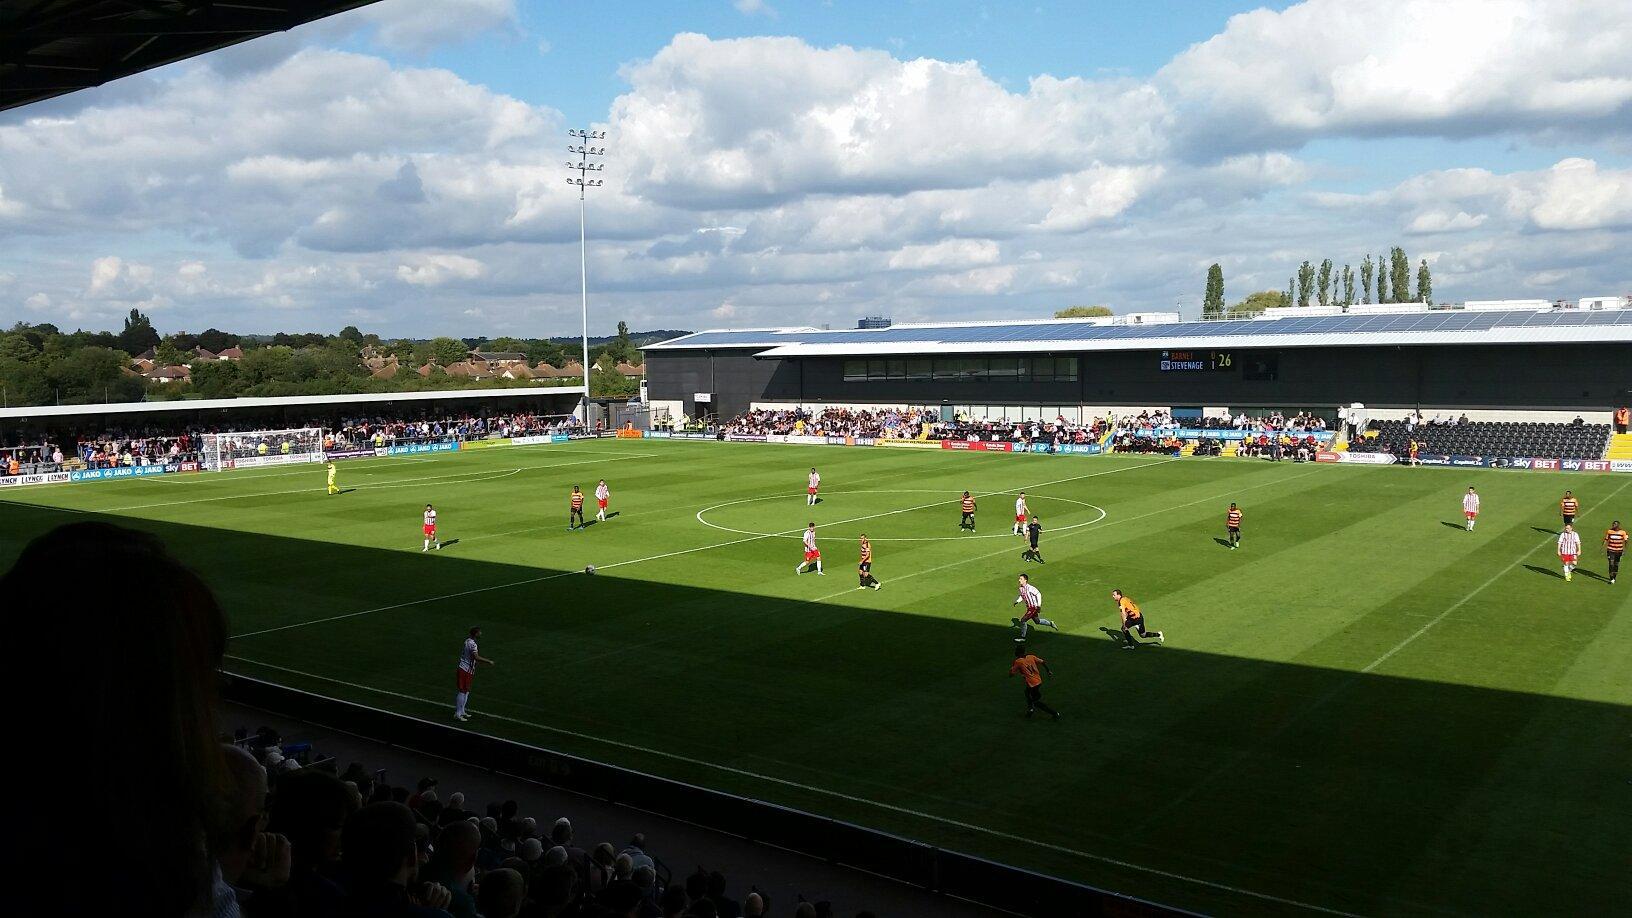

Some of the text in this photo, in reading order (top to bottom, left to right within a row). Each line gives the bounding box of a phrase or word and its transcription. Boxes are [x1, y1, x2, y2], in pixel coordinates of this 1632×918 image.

[1218, 353, 1232, 367] 26
[1171, 361, 1204, 370] STEVENAGE
[165, 462, 197, 473] sky BET
[1513, 458, 1558, 469] sky BET
[1562, 460, 1609, 471] sky BET
[113, 468, 132, 476] JAKO
[144, 465, 162, 473] JAKO
[82, 471, 101, 479] JAKO
